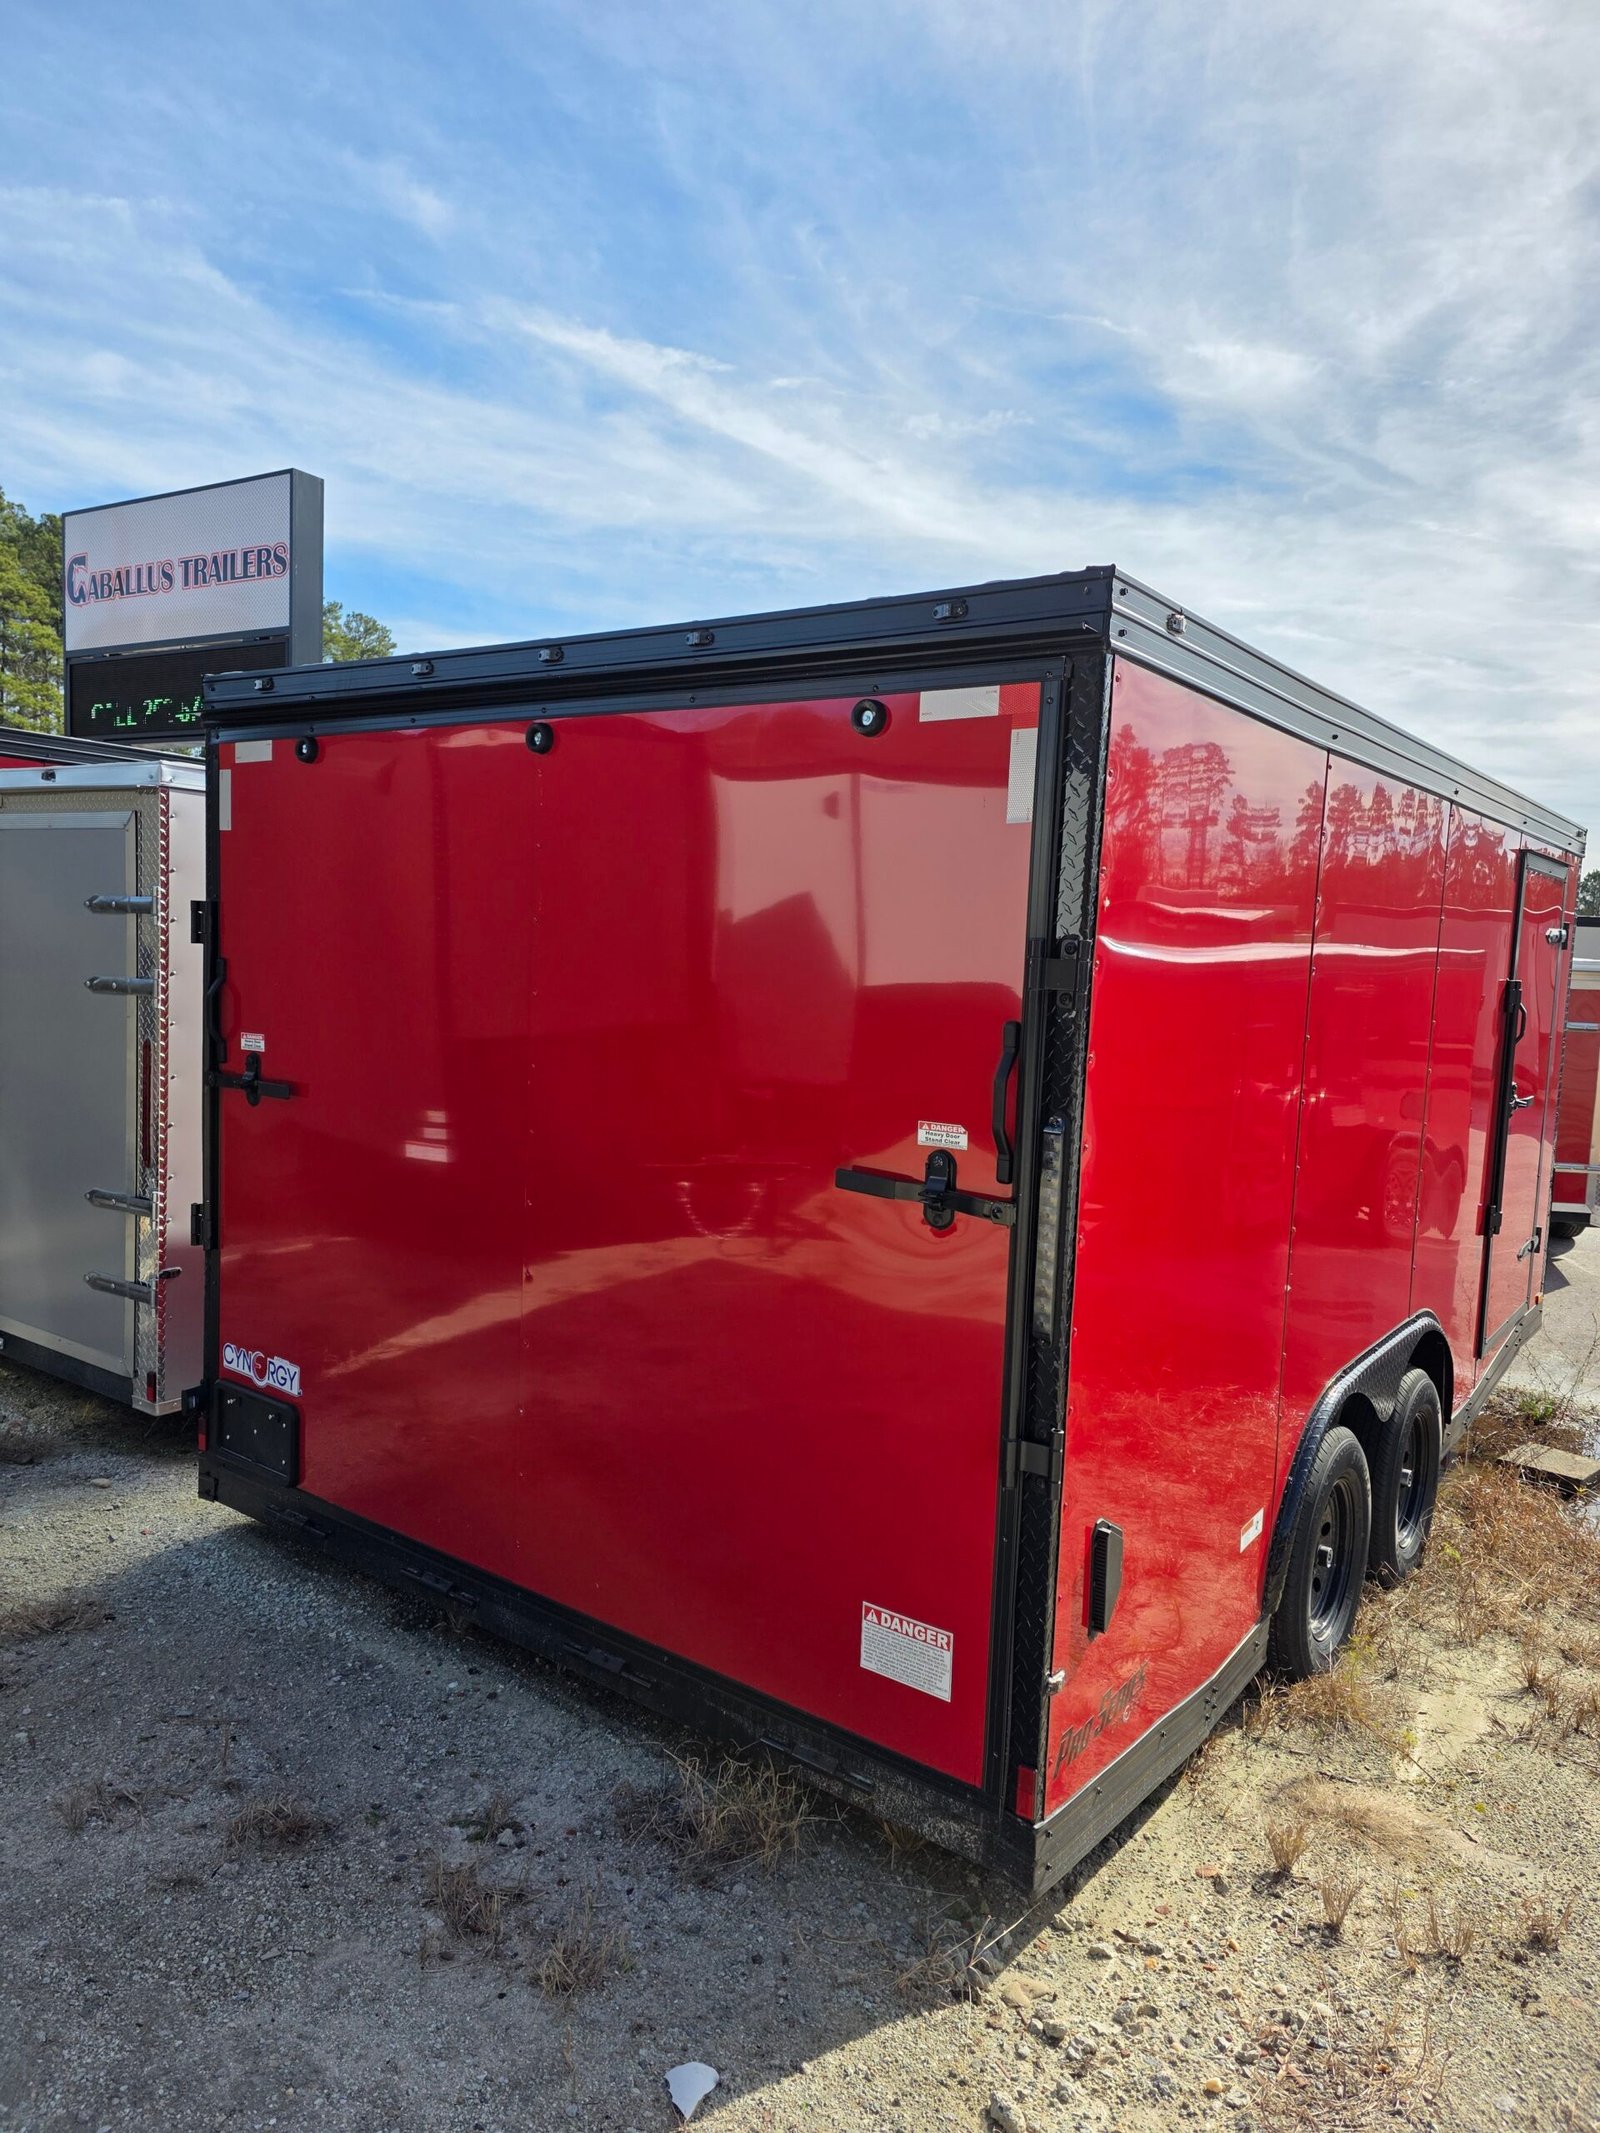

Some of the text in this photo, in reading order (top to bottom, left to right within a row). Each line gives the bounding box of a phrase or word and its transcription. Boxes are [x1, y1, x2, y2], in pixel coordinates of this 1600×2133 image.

[67, 544, 287, 604] CABALLUS TRAILERS
[925, 1130, 944, 1138] Heavy
[880, 1612, 949, 1650] DANGER
